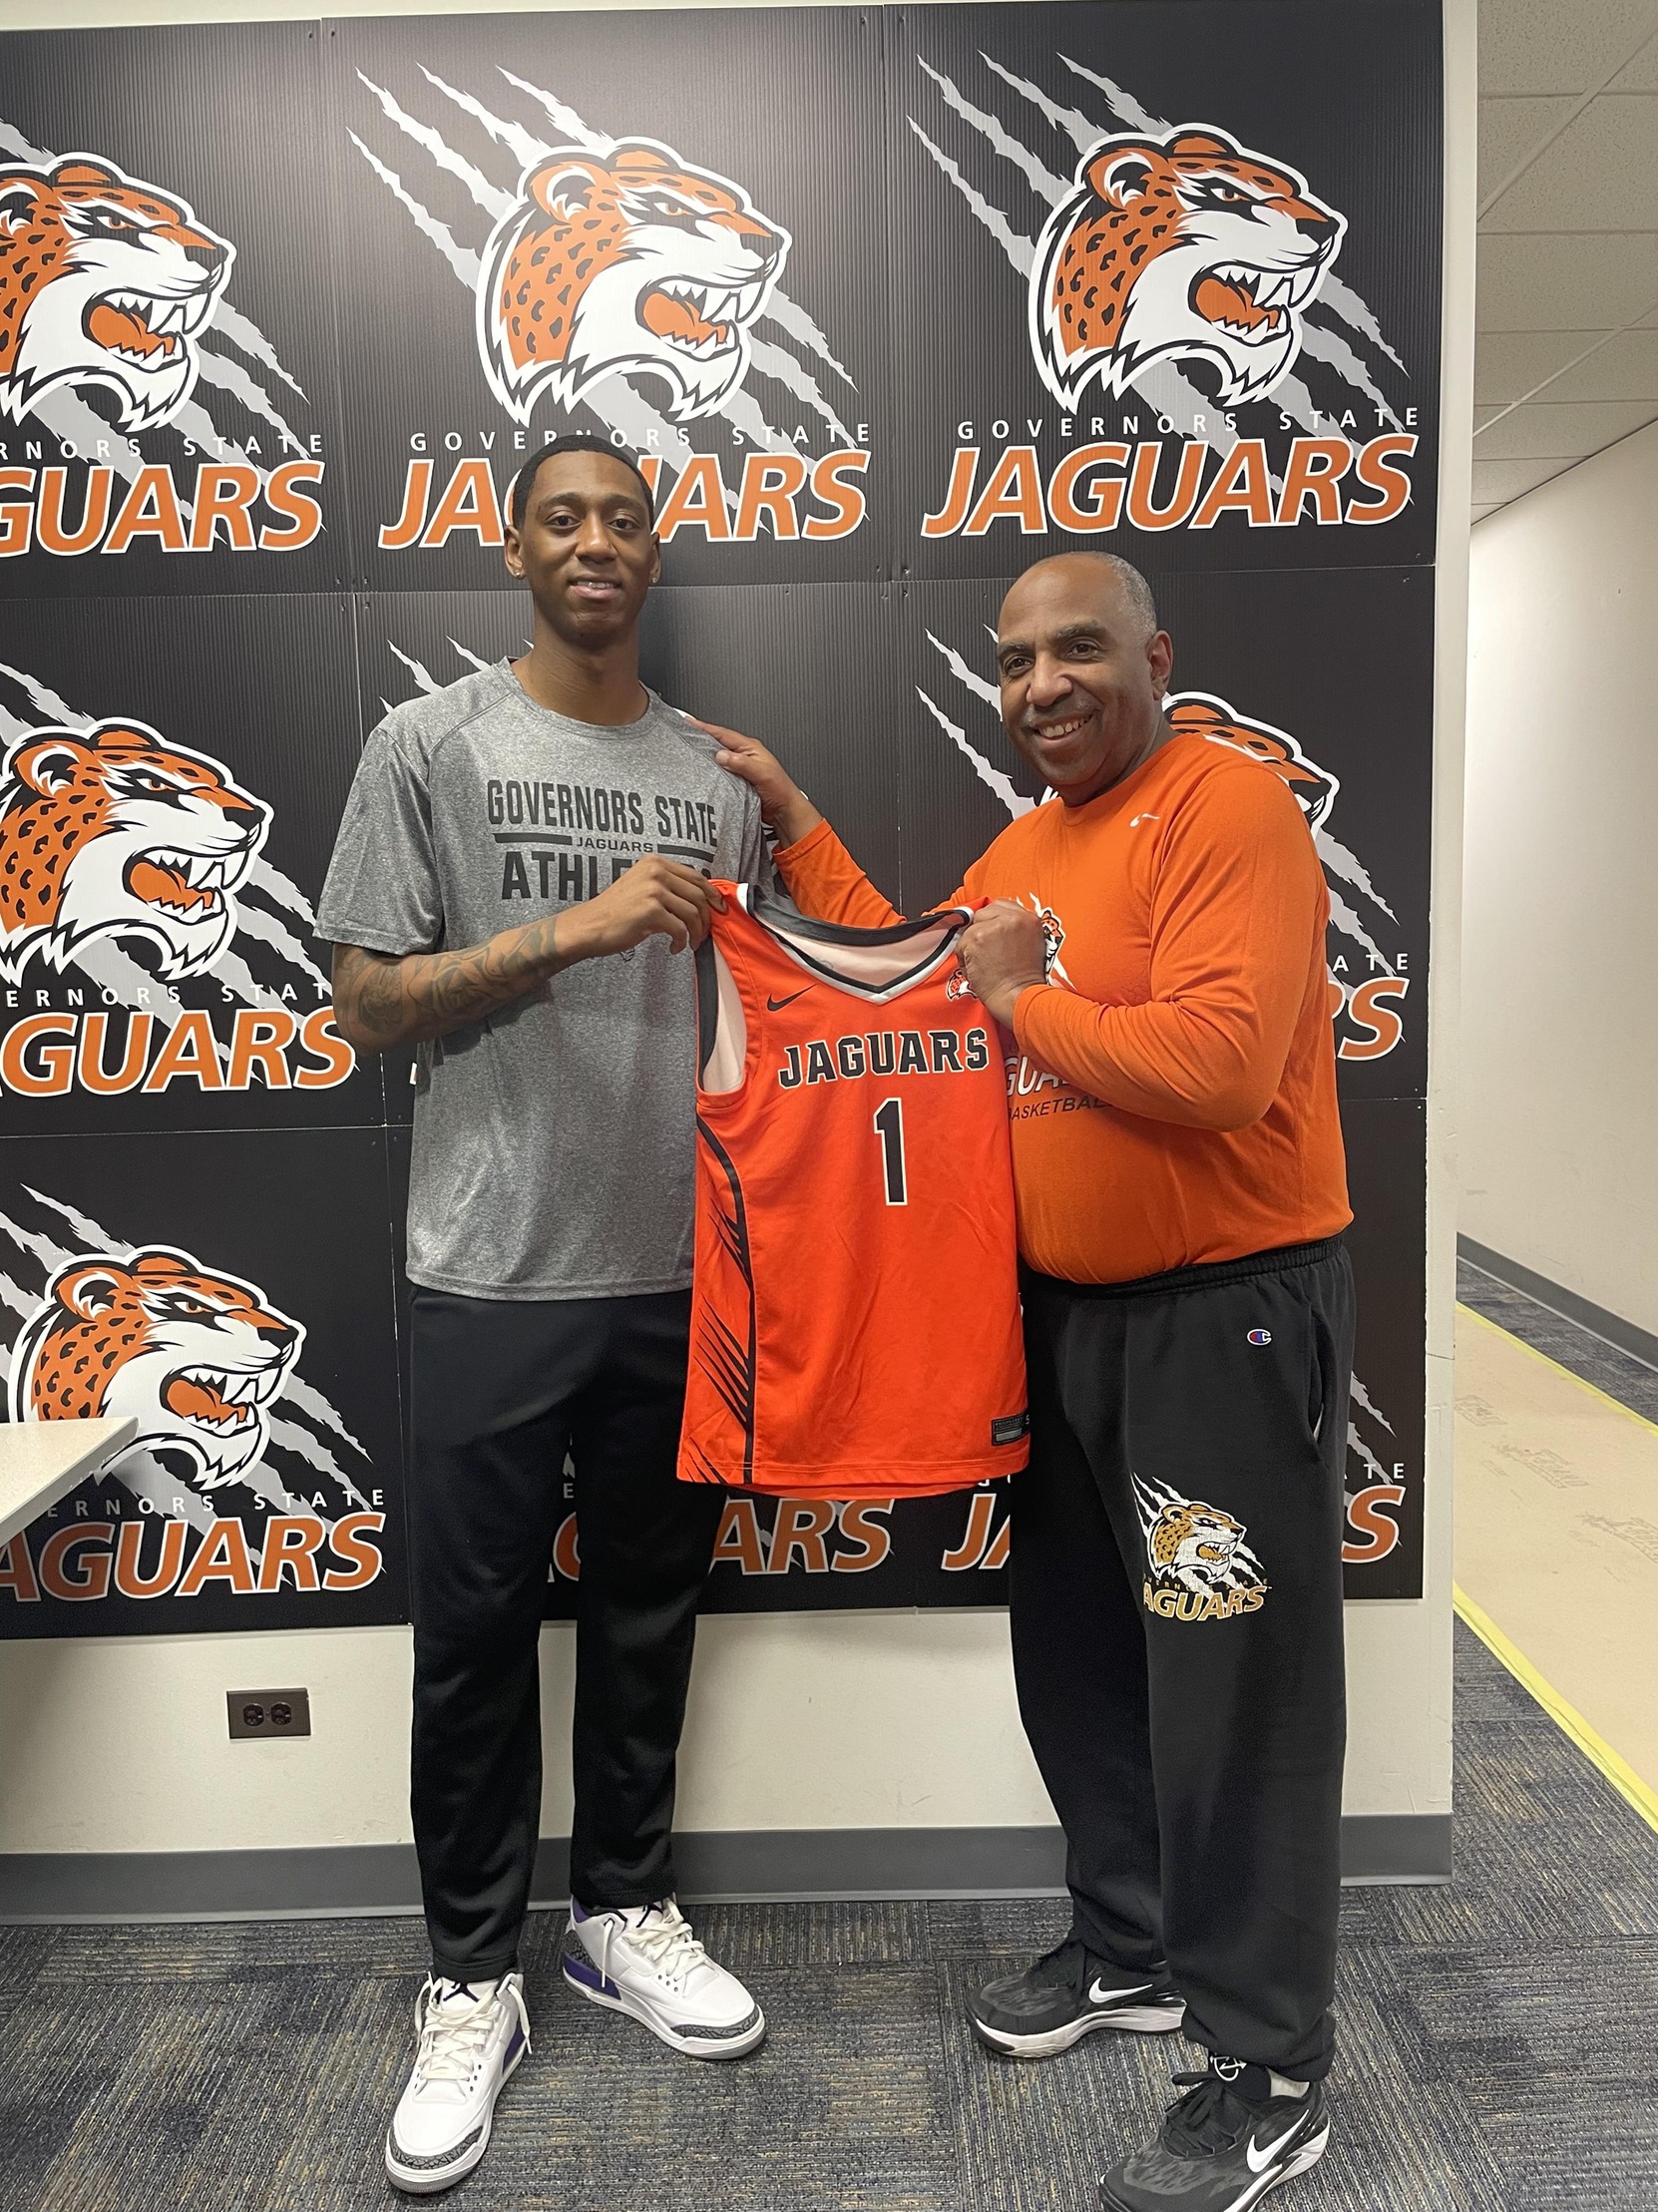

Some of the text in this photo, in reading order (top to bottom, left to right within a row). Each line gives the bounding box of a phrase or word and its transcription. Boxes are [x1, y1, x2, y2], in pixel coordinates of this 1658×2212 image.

[732, 423, 869, 445] STATE
[958, 407, 1418, 439] GOVERNORS STATE
[184, 434, 322, 456] STATE
[921, 433, 1419, 538] JAGUARS
[377, 449, 871, 549] JAARS
[487, 779, 718, 848] GOVERNORS STATE
[576, 836, 653, 853] JAGUARS
[1333, 953, 1409, 972] ATE
[221, 983, 327, 1002] STAT
[778, 1027, 989, 1090] JAGUARS
[1008, 1095, 1113, 1120] ASKETBAL
[874, 1098, 908, 1206] 1
[254, 1489, 384, 1510] STATE
